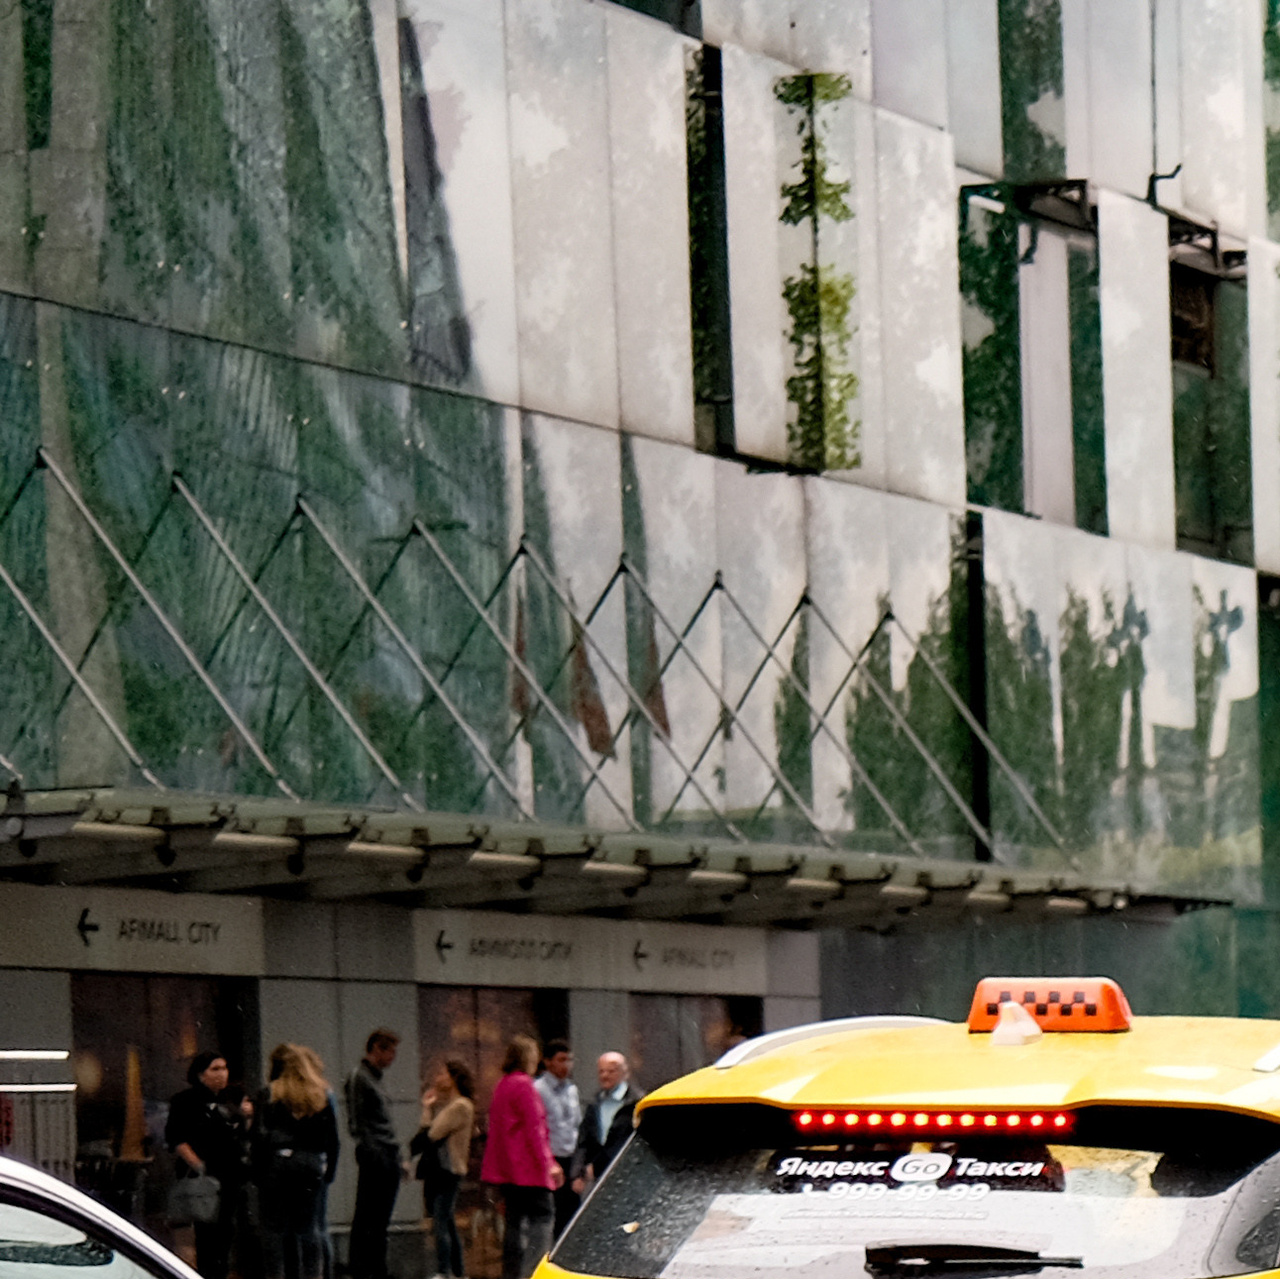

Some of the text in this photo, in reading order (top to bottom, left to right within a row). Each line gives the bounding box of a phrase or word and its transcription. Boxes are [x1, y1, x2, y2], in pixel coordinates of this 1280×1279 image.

[187, 921, 222, 945] CITY
[776, 1157, 1046, 1178] Яндекс Go Такси
[828, 1182, 991, 1201] 999-99-99
